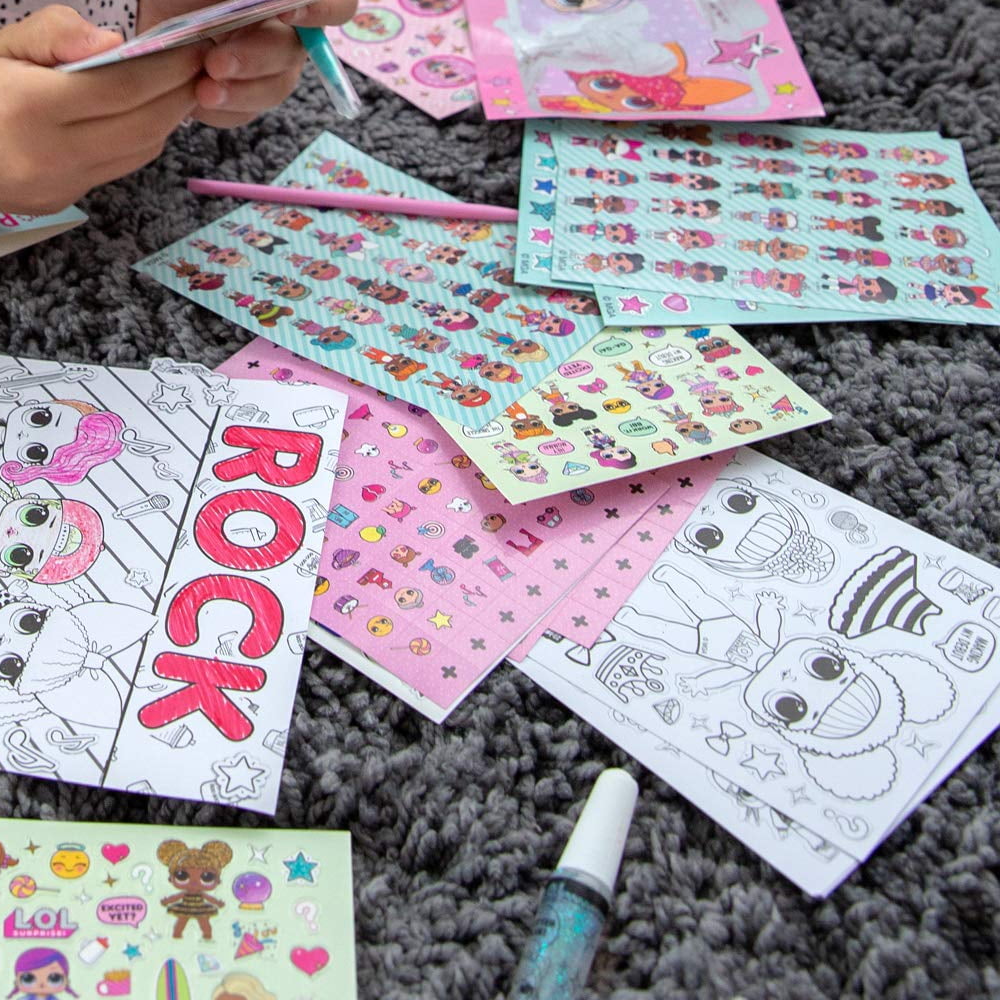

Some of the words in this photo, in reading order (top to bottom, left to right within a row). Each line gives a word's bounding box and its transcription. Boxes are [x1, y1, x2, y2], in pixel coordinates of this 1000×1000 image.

[137, 422, 324, 743] ROCK
[960, 628, 973, 640] MY
[951, 638, 971, 662] DEBUT
[966, 636, 988, 664] MAKING
[101, 903, 143, 912] EXCITED
[108, 911, 136, 922] YET?
